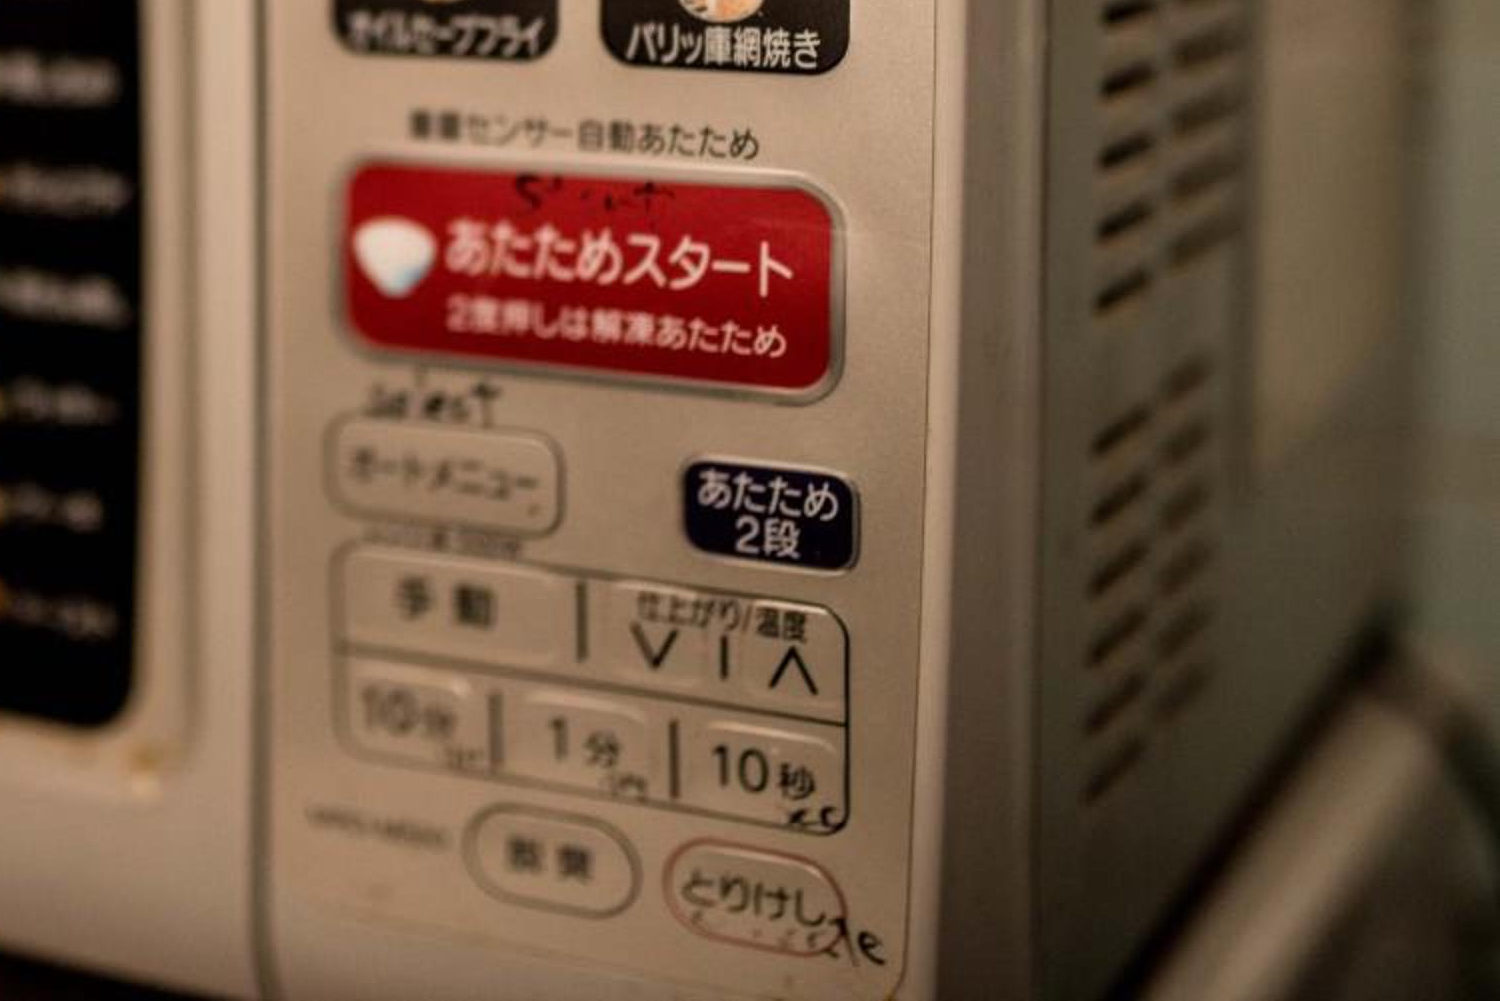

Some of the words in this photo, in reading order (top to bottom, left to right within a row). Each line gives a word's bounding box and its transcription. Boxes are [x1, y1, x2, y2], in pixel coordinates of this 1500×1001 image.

[444, 216, 794, 298] あたためスタート
[696, 468, 839, 520] あたため
[733, 514, 801, 560] 2段
[711, 744, 817, 802] 10秒
[681, 868, 828, 928] とりけし
